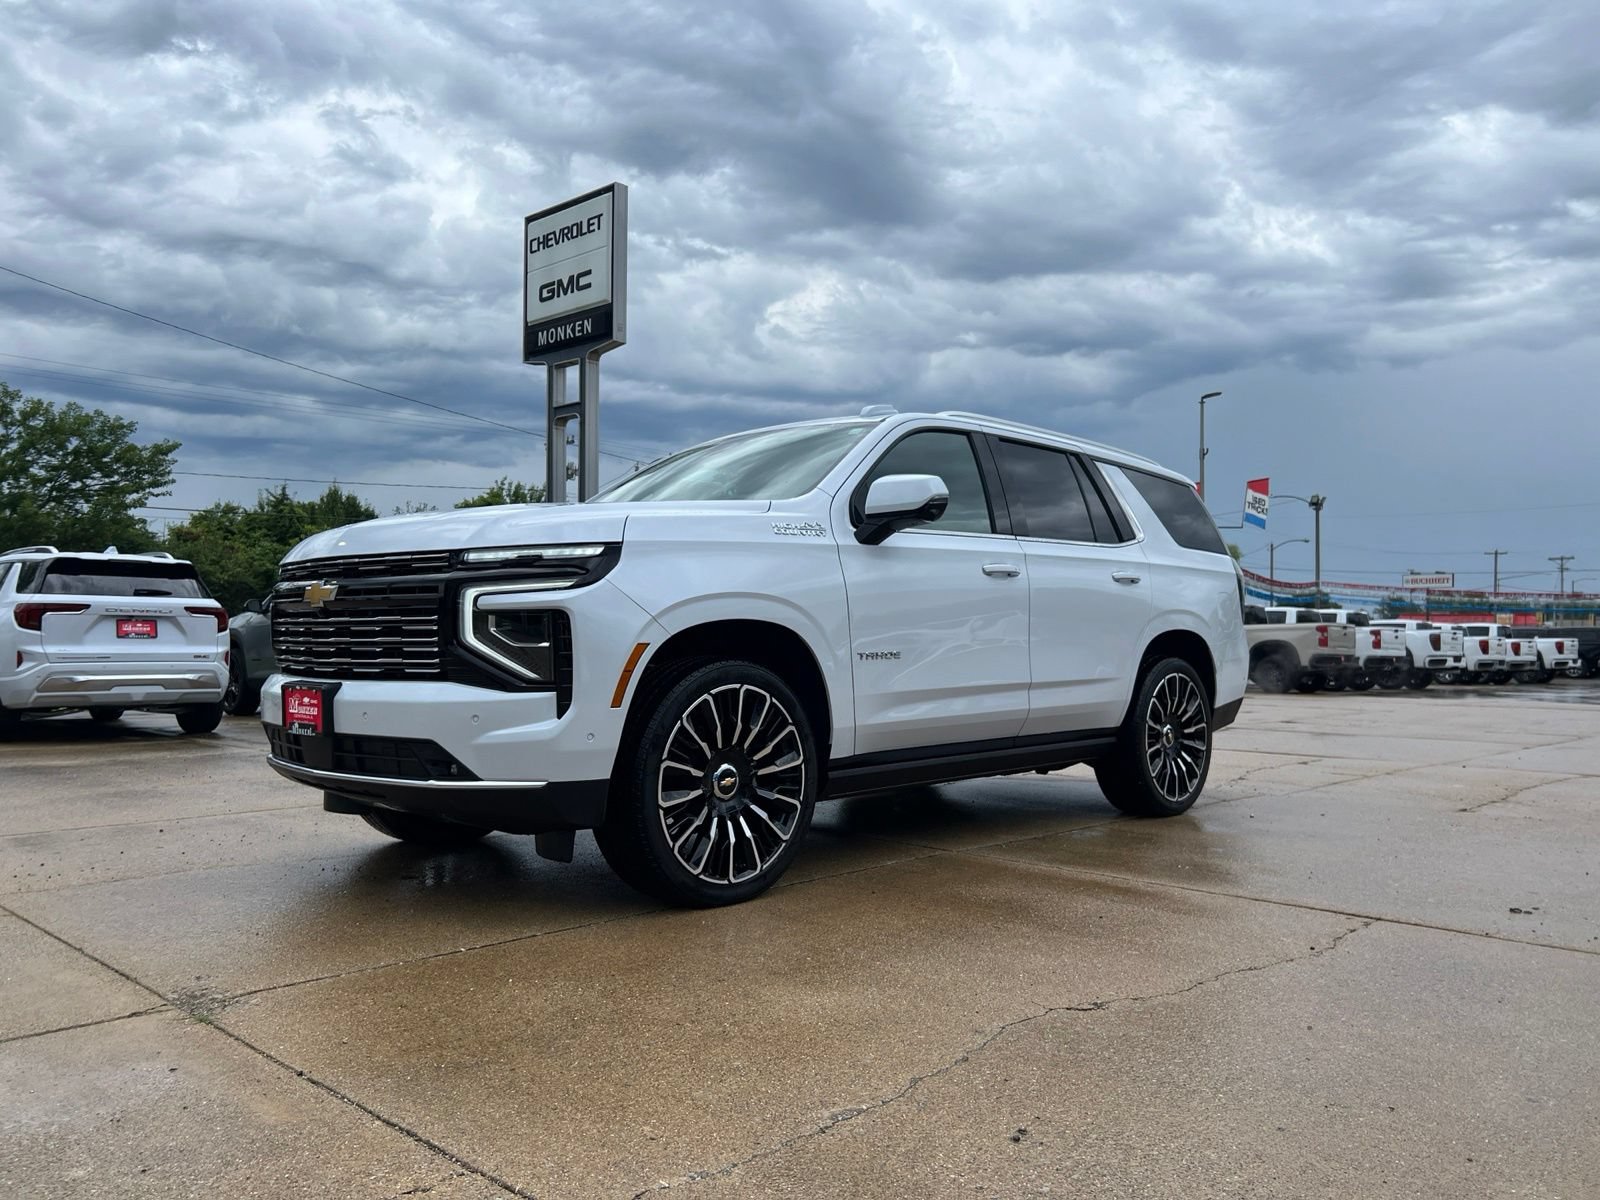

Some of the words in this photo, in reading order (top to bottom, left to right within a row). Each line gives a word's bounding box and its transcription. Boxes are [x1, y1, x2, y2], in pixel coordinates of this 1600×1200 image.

[529, 213, 603, 254] CHEVROLET
[538, 269, 592, 303] GMC
[538, 318, 592, 347] MONKEN
[857, 651, 902, 661] TAHOE
